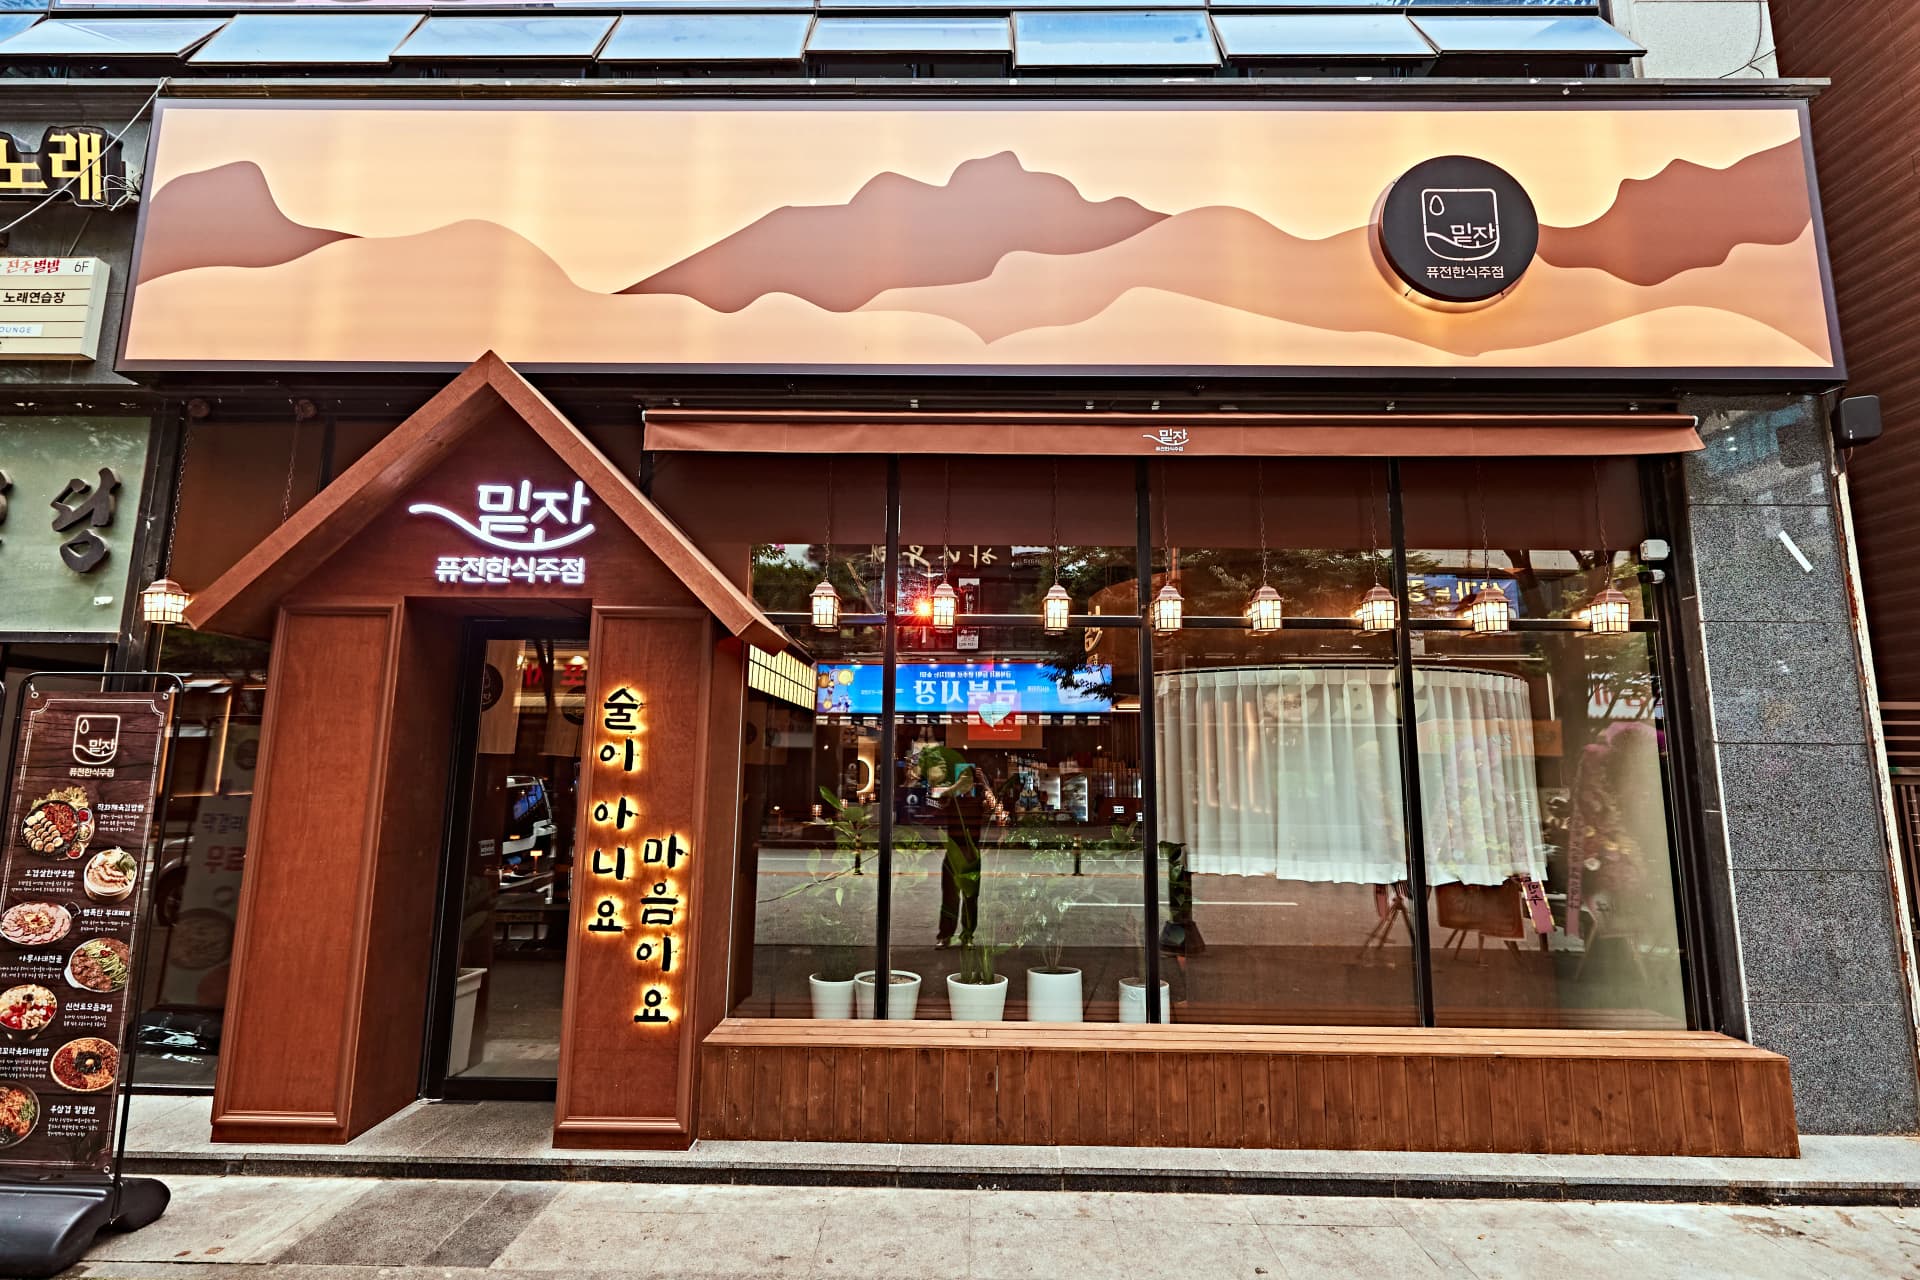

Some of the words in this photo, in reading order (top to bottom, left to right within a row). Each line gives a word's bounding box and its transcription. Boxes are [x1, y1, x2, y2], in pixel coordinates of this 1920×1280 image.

[74, 260, 90, 273] 6F
[1426, 266, 1504, 279] 퓨전한식주점
[4, 291, 66, 304] 노래연습장
[435, 556, 586, 584] 퓨전한식주점
